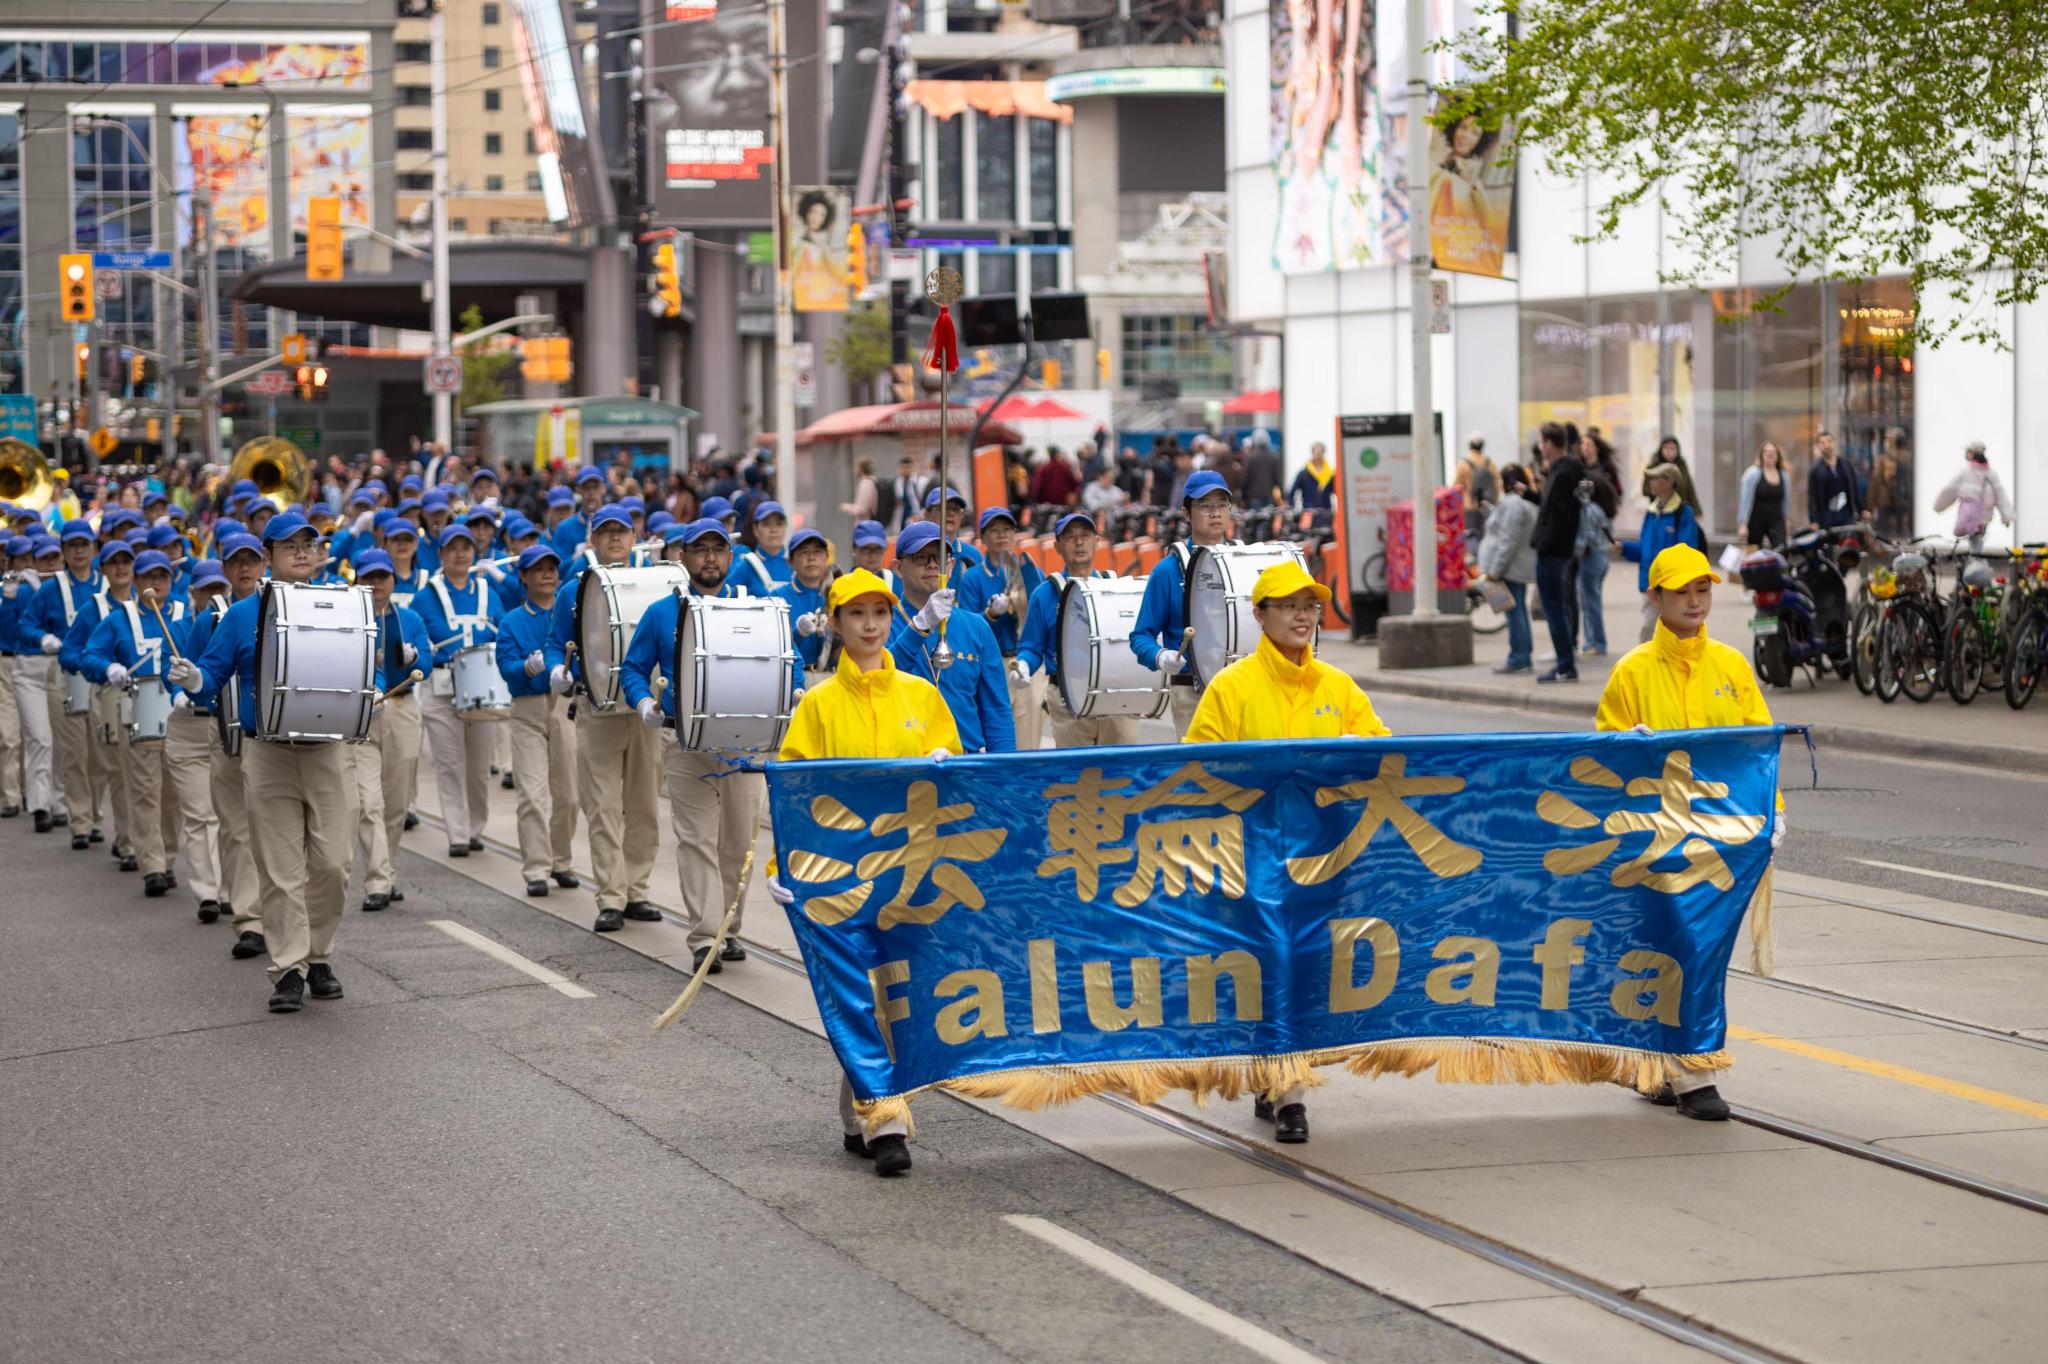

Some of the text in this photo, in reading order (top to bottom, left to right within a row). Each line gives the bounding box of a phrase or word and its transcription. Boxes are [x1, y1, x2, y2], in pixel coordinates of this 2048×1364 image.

[788, 750, 1767, 932] 法輪大法
[867, 917, 1684, 1064] Falun Dafa
